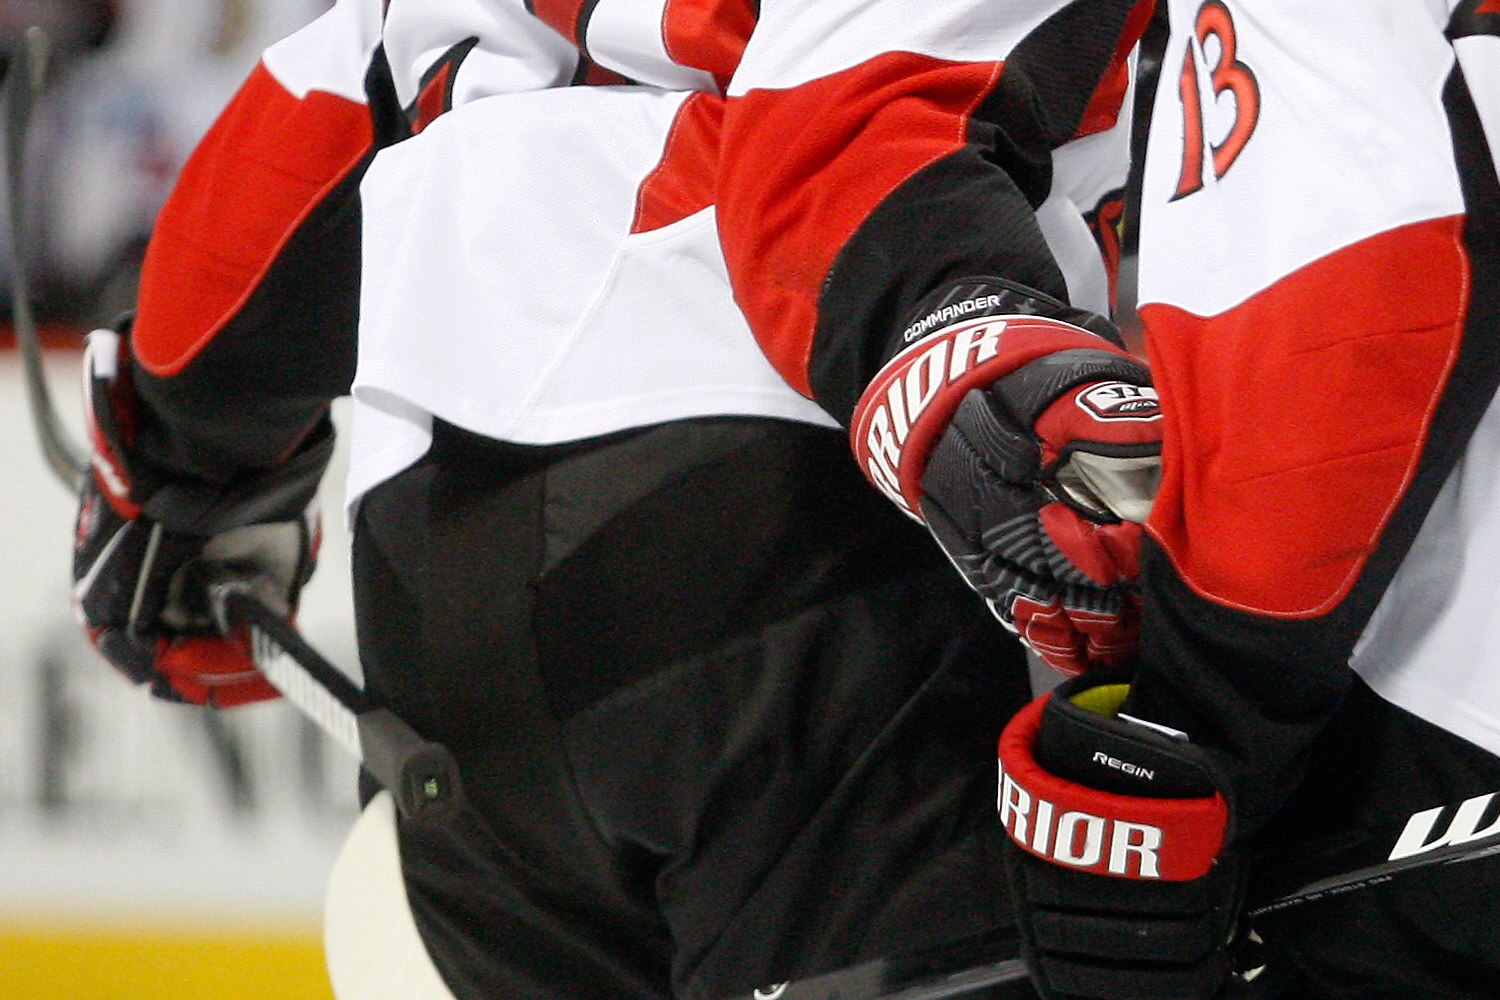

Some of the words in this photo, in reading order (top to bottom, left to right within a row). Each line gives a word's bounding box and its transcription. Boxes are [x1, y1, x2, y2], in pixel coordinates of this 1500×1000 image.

[903, 295, 1001, 342] COMMANDER
[1093, 751, 1155, 780] REGIN
[997, 758, 1168, 878] RIOR
